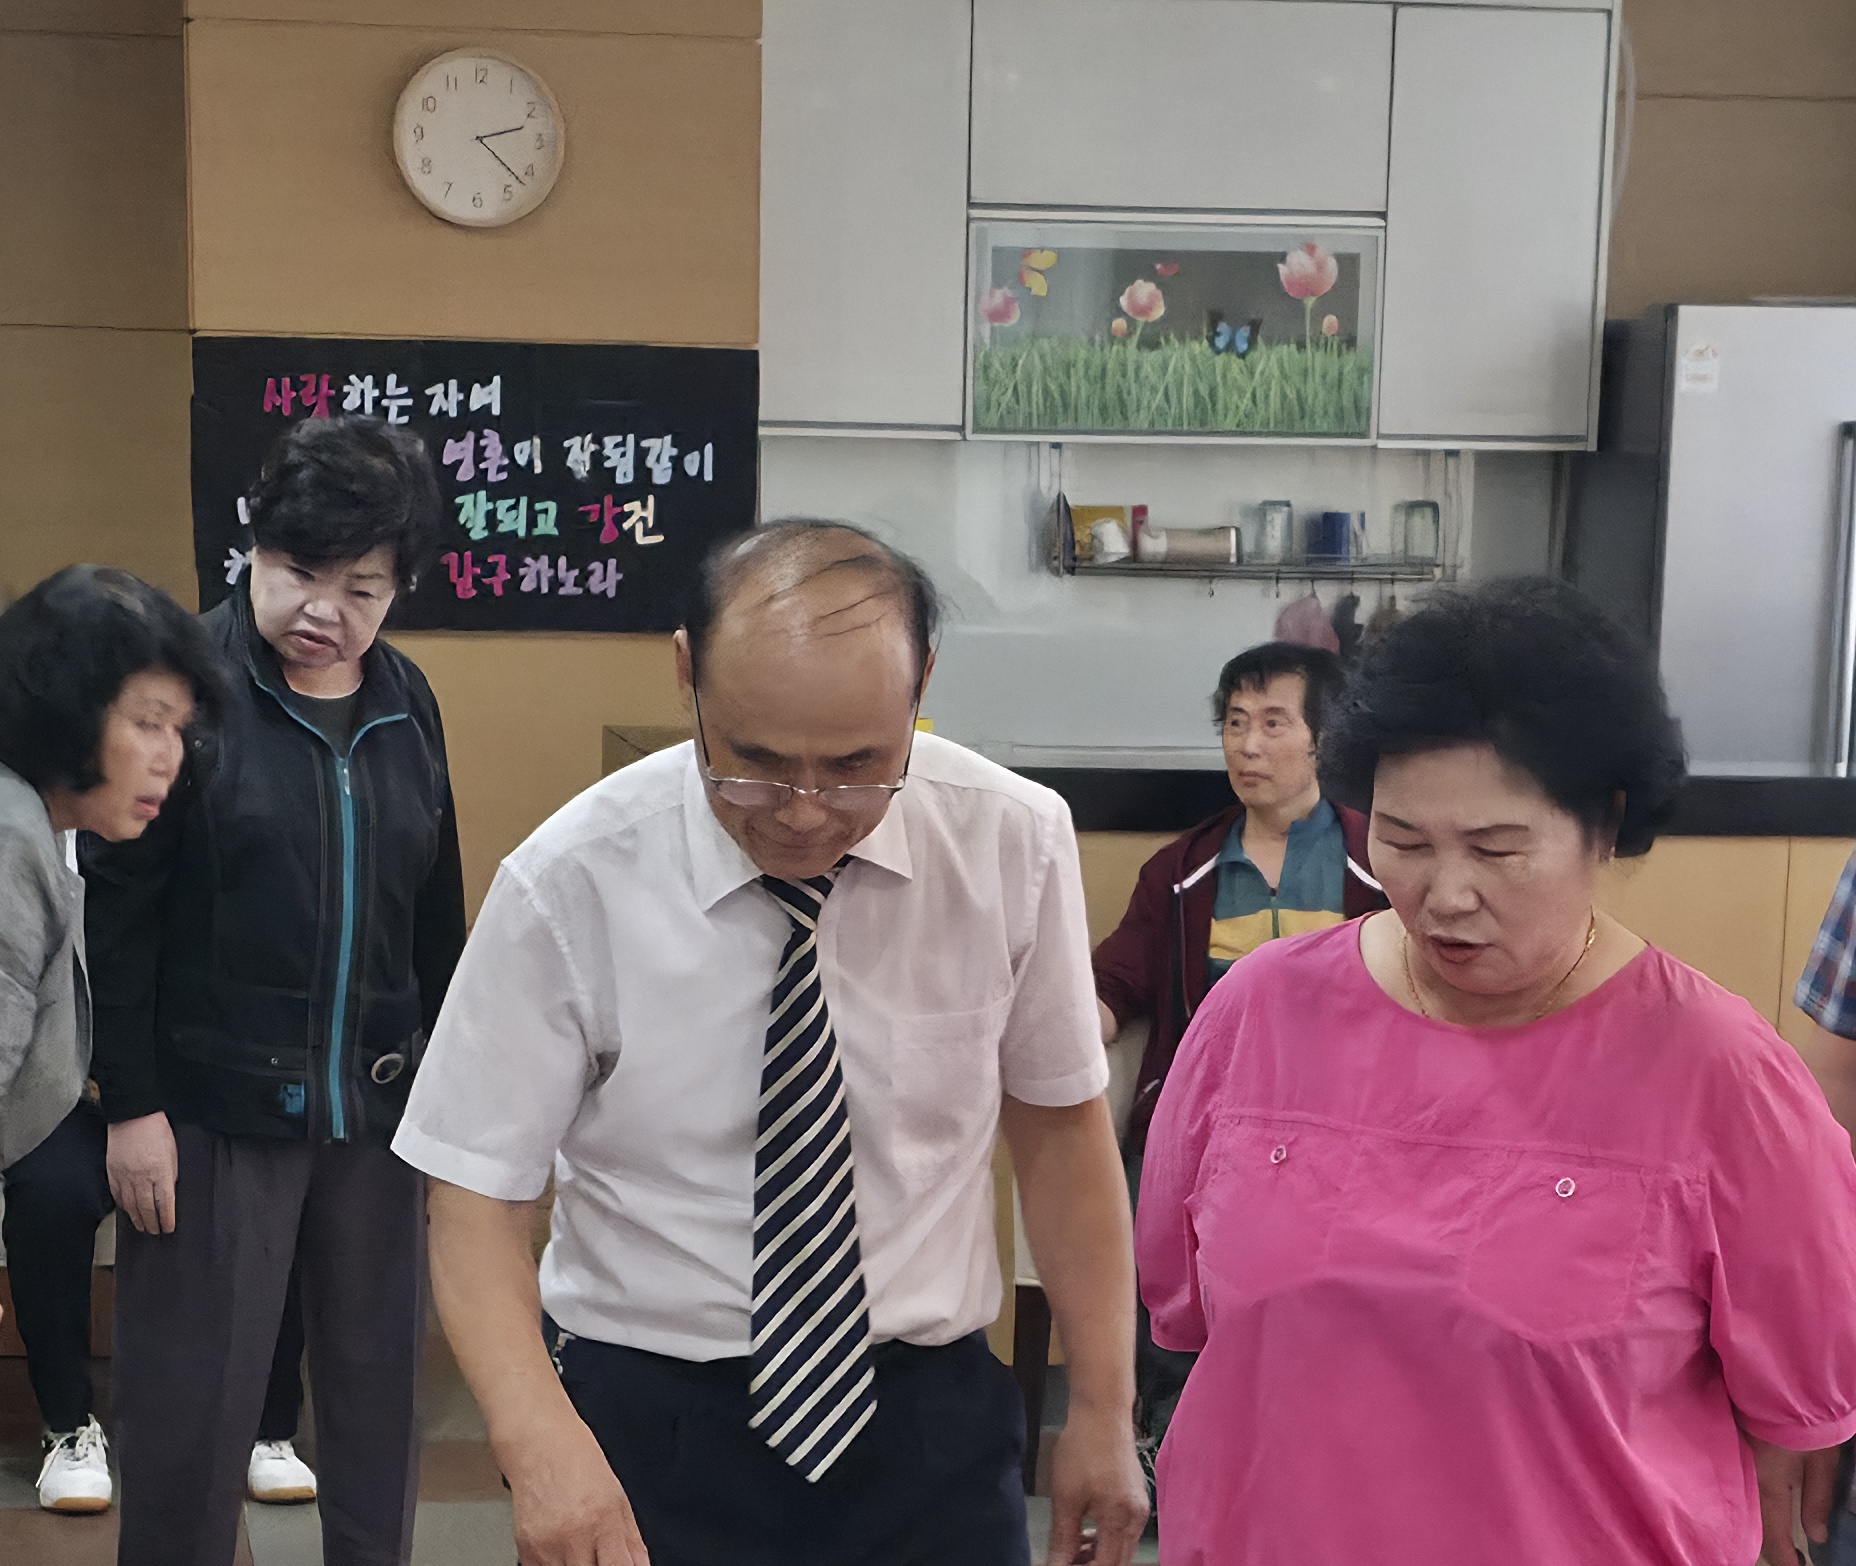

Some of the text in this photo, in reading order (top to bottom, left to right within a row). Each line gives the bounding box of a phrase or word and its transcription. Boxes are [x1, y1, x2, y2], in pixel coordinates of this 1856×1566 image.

[446, 75, 458, 91] 11
[475, 66, 488, 84] 12
[422, 96, 436, 113] 10
[421, 157, 432, 175] 8
[443, 182, 454, 198] 7
[503, 184, 513, 202] 5
[472, 192, 483, 208] 6
[263, 373, 501, 424] 사랑하는 자여
[442, 428, 542, 482] 영혼이
[454, 490, 664, 545] 잘되고 강건
